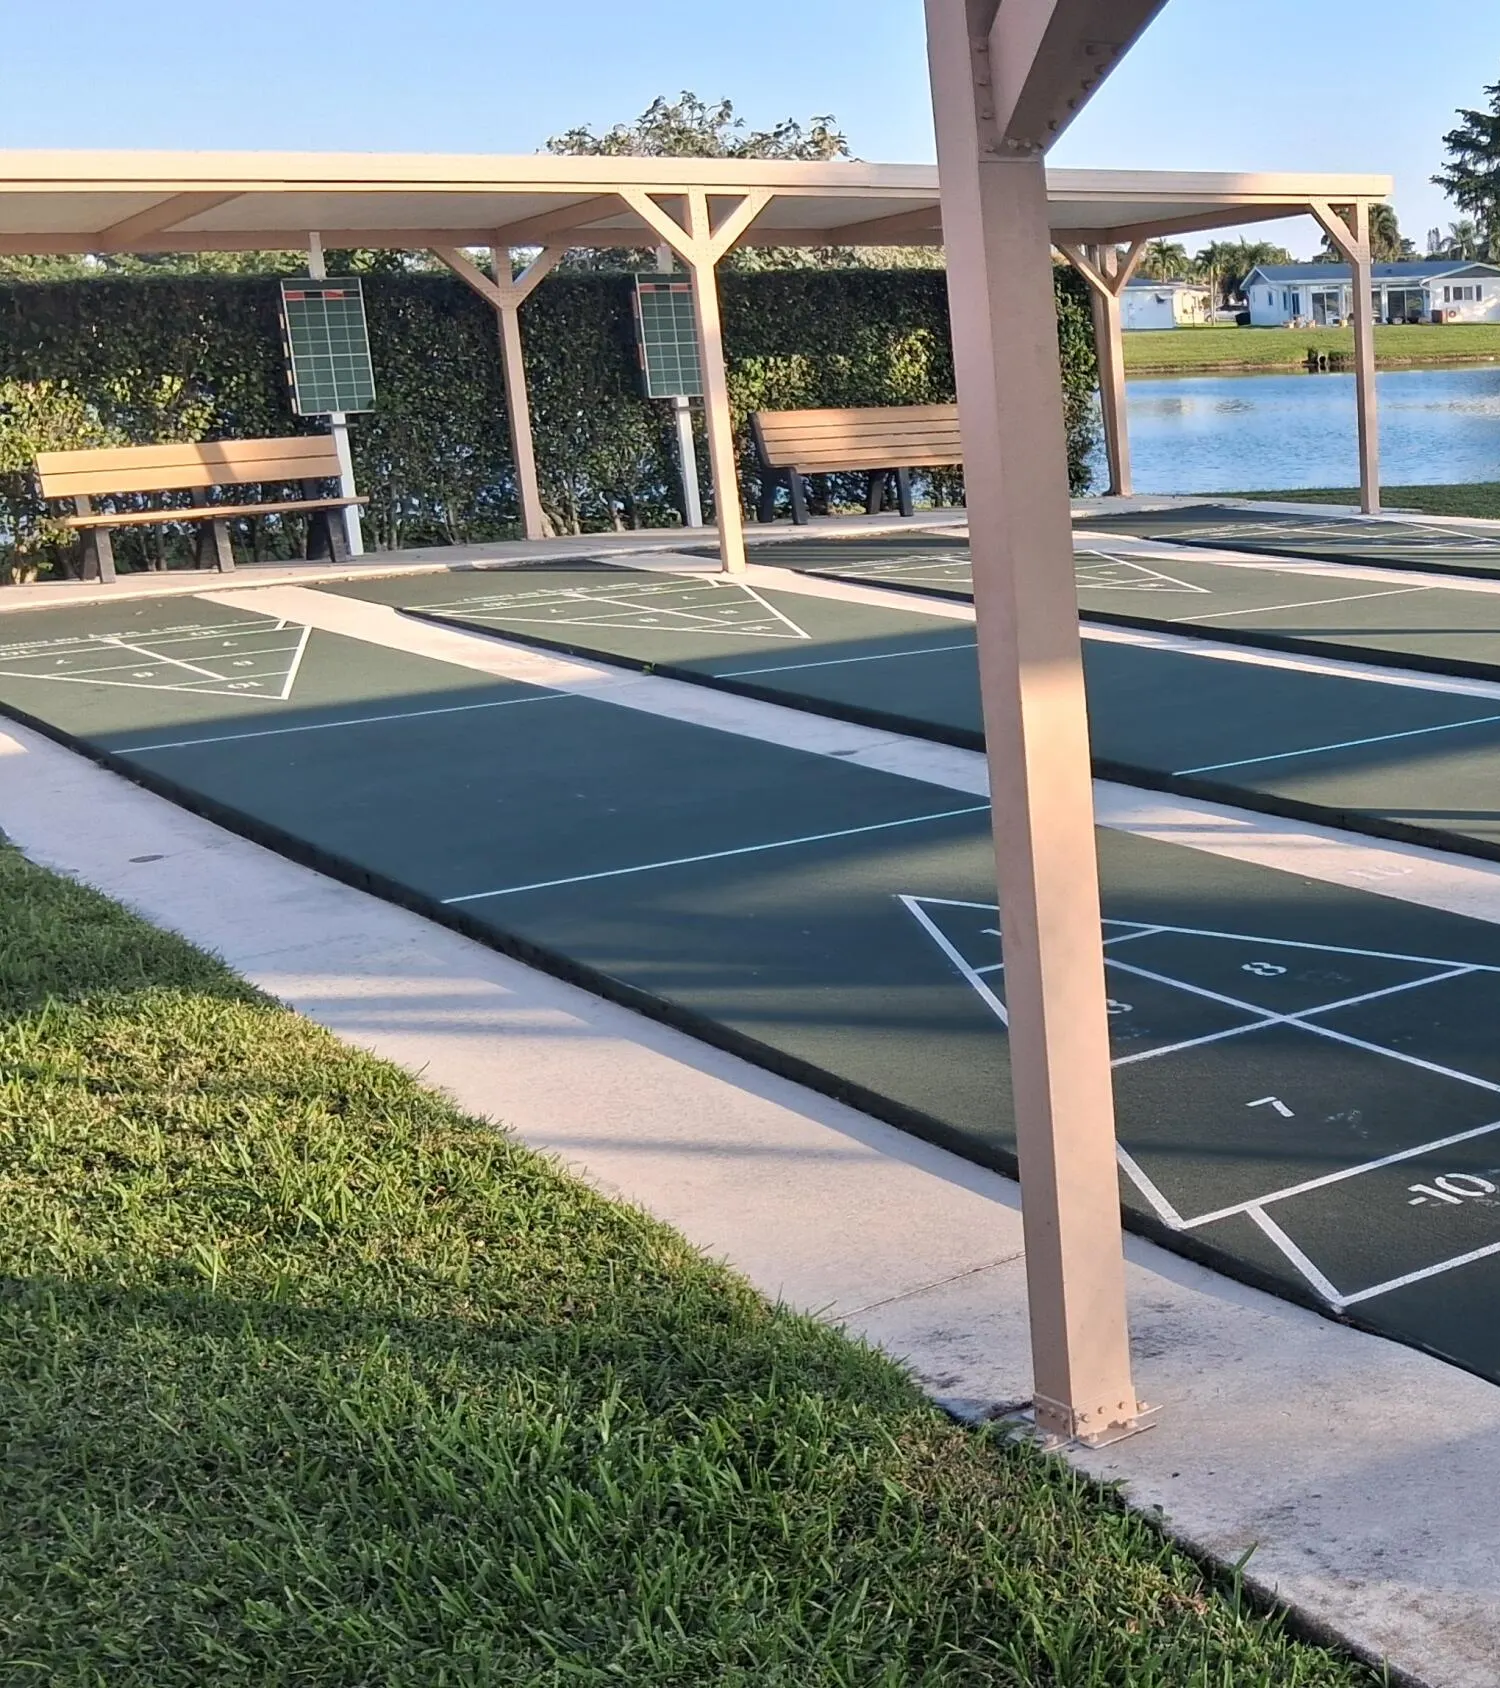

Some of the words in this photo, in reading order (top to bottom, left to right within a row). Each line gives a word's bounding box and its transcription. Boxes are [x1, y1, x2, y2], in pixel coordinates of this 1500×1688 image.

[1242, 961, 1287, 976] 8
[1245, 1095, 1295, 1118] 7
[1407, 1172, 1497, 1206] -10
